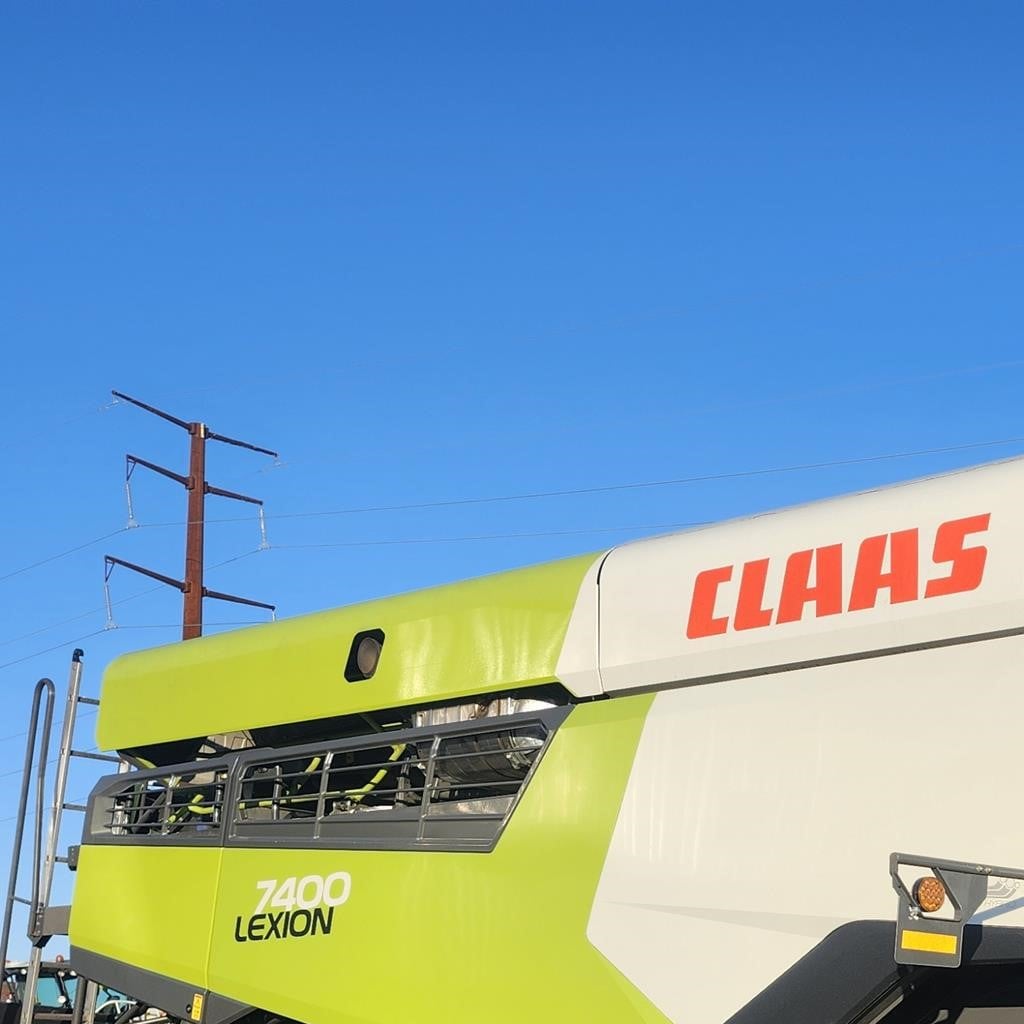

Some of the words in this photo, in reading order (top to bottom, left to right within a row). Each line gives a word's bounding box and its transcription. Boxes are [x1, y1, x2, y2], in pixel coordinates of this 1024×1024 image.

[687, 513, 991, 640] CLAAS
[254, 871, 352, 914] 7400
[234, 906, 335, 942] LEXION
